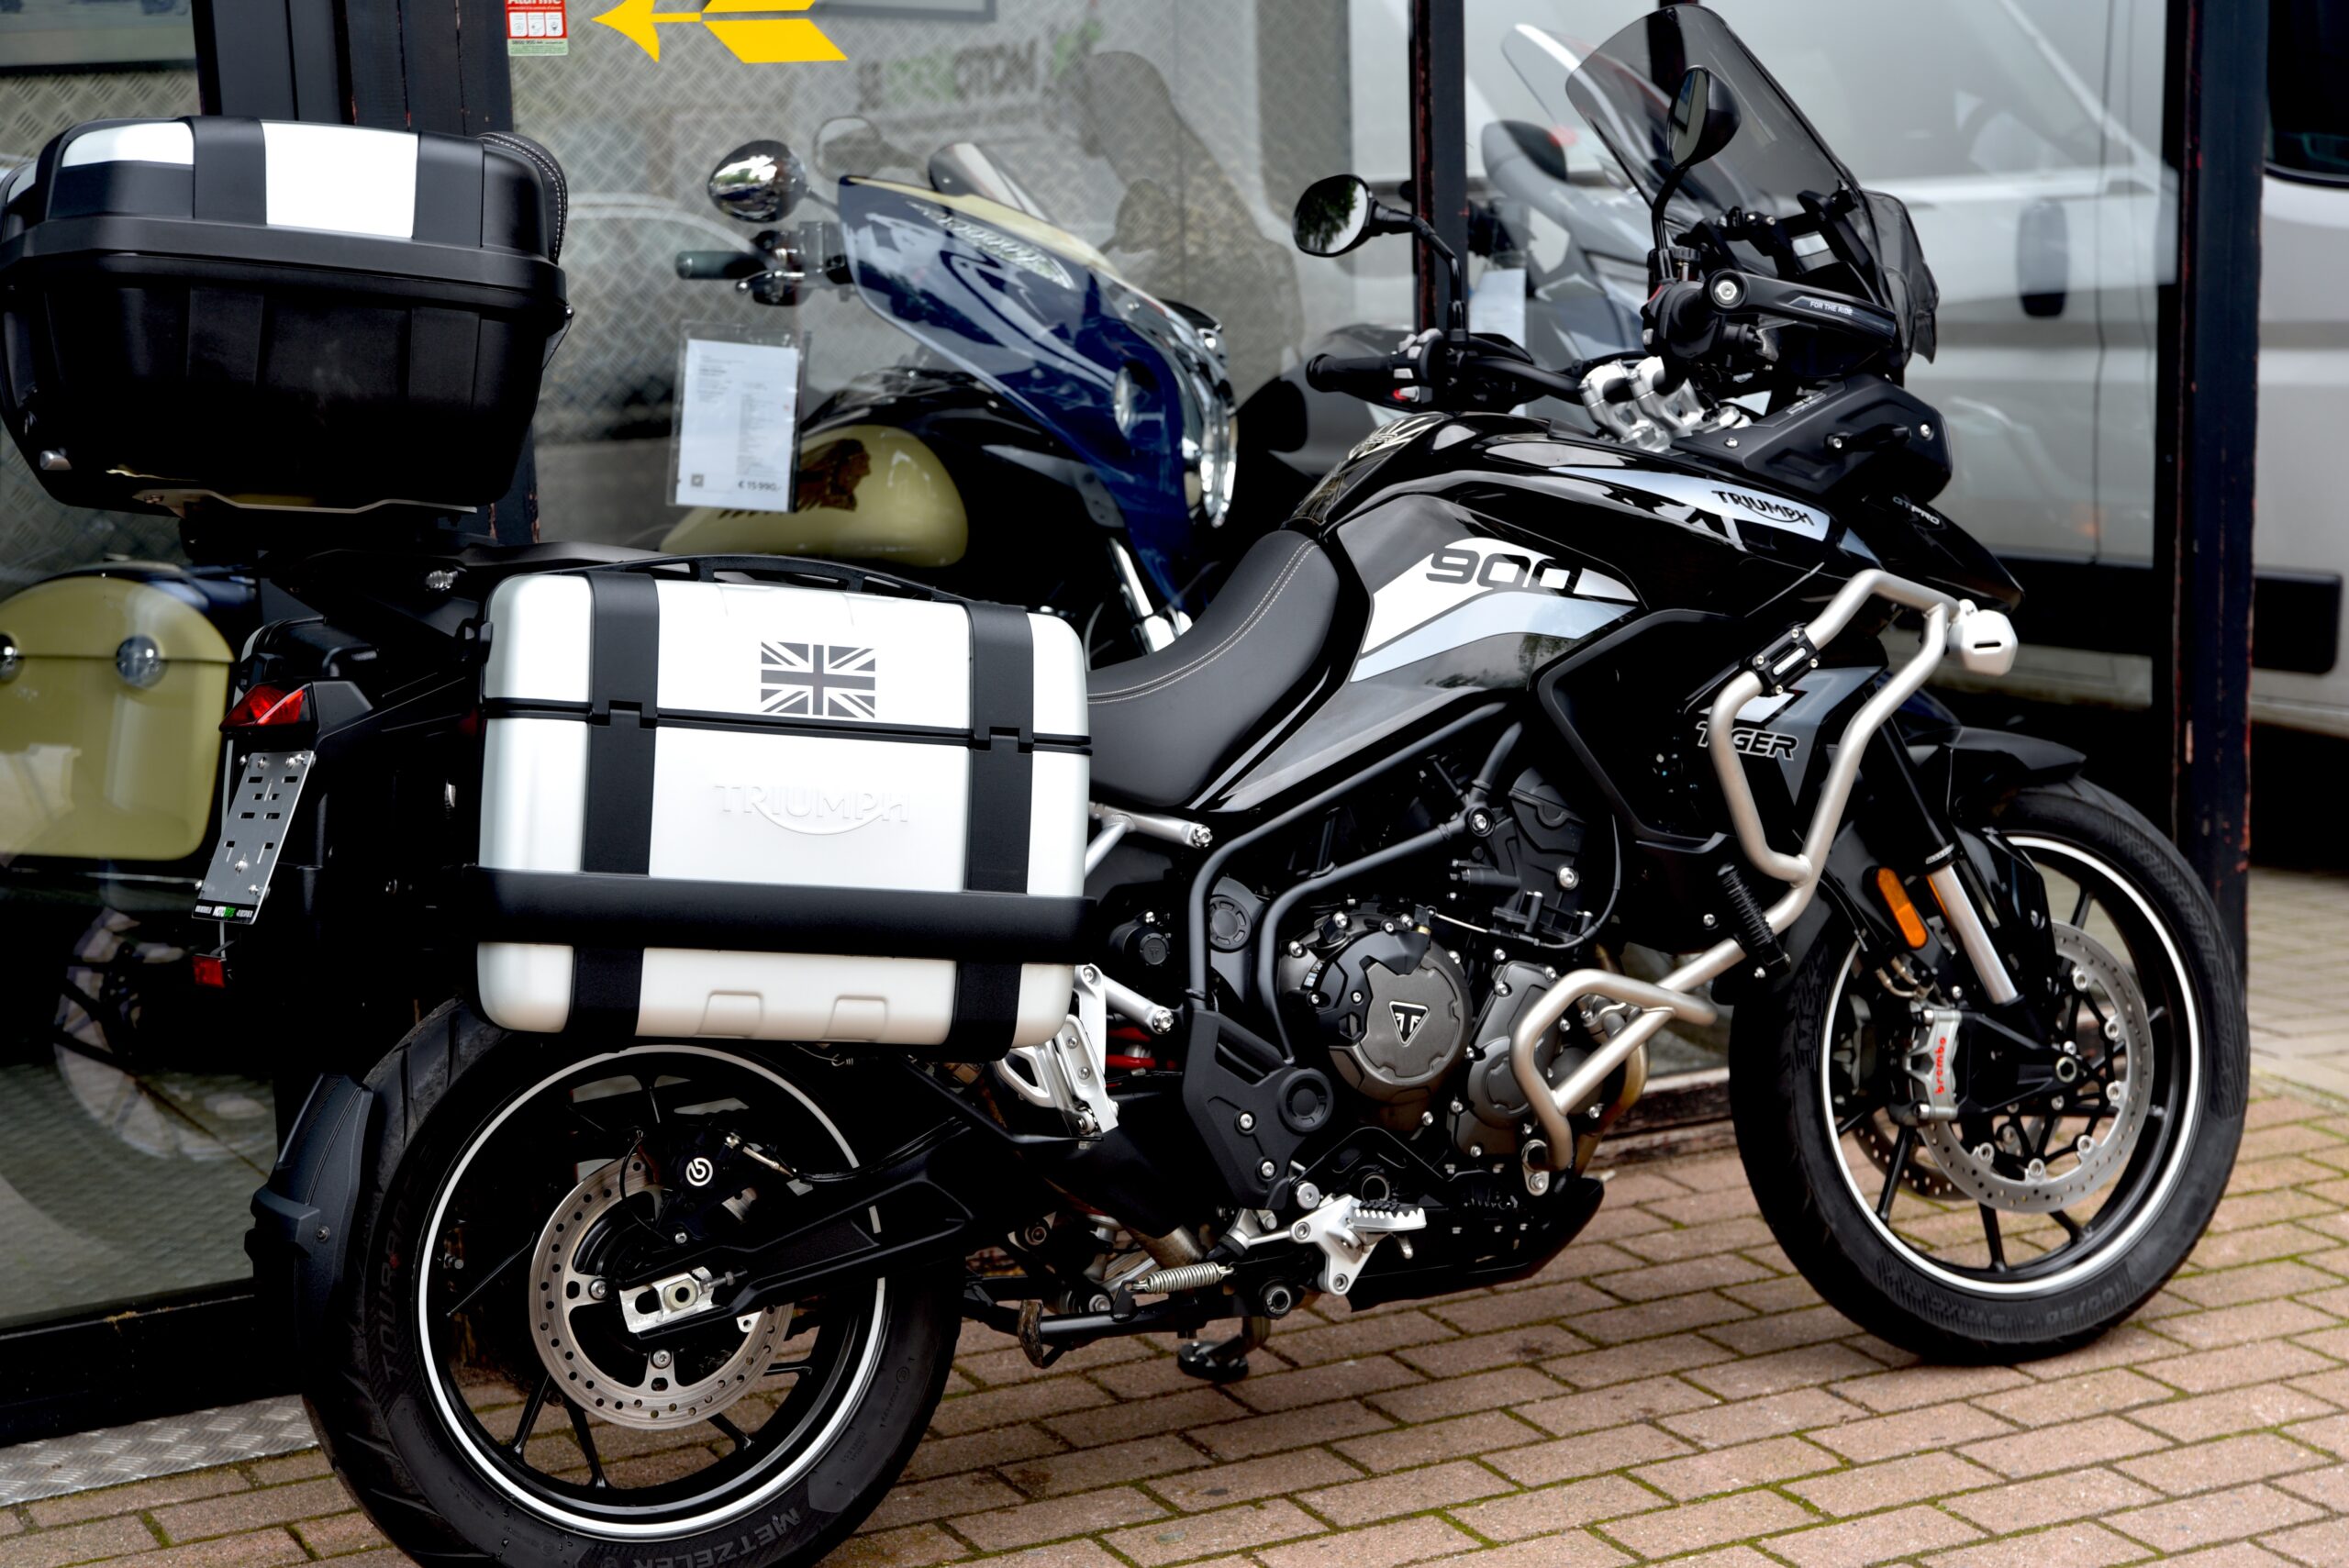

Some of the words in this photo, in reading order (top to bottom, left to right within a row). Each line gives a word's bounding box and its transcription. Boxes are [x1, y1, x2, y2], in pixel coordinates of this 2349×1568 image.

[1809, 300, 1823, 309] FOR
[1824, 304, 1837, 312] THE
[1838, 306, 1853, 316] RIDE
[1711, 490, 1814, 527] TRIUMPH
[1426, 549, 1576, 592] 900
[1696, 720, 1798, 761] TGER
[713, 784, 909, 836] TRIUMPH
[1933, 1037, 1947, 1095] brembo
[632, 1507, 803, 1568] METZELER
